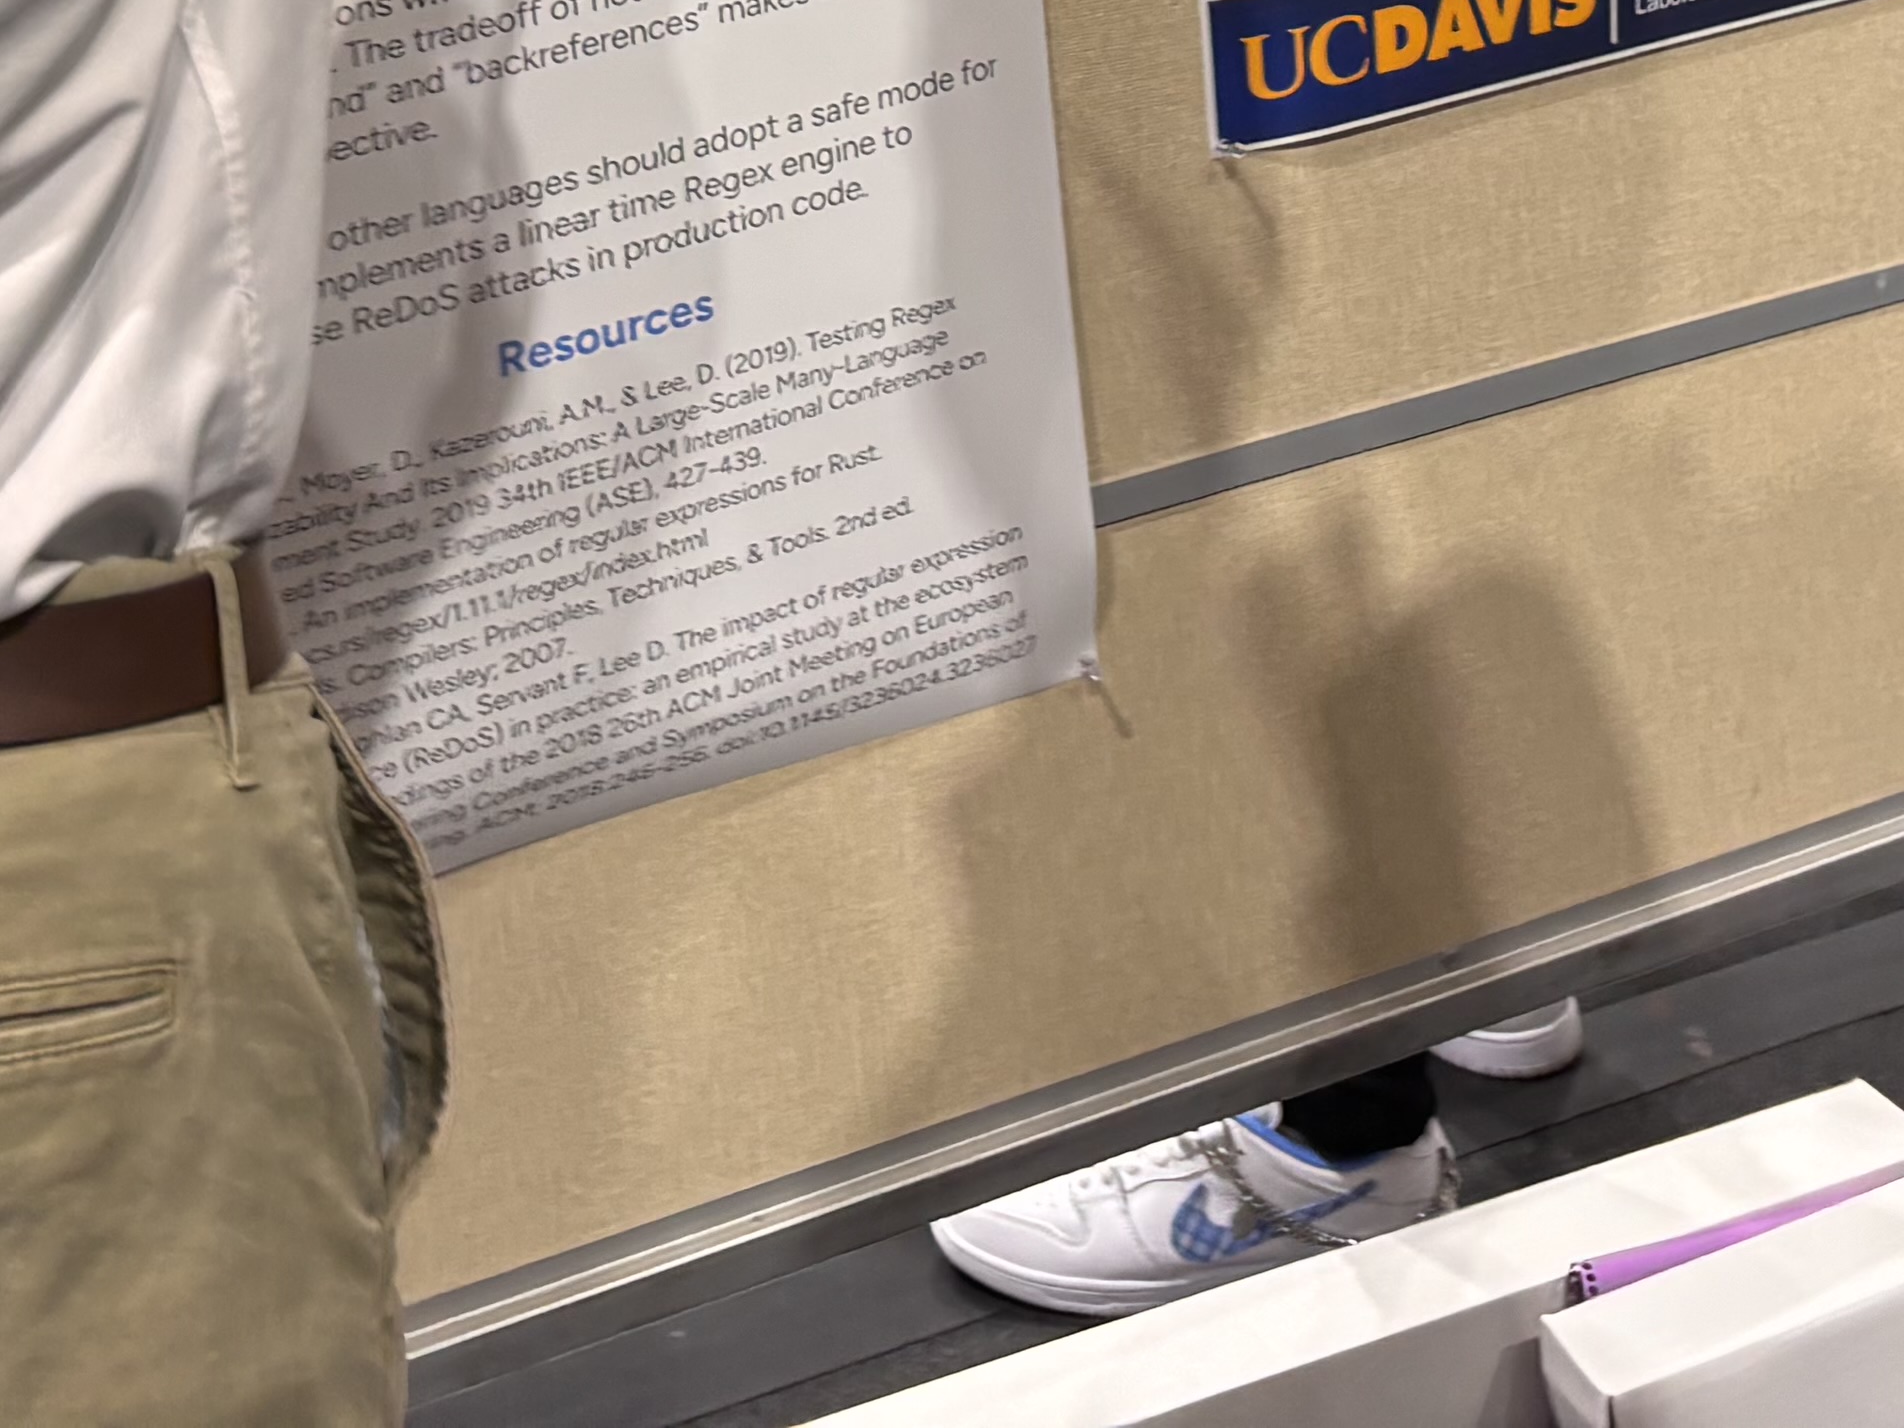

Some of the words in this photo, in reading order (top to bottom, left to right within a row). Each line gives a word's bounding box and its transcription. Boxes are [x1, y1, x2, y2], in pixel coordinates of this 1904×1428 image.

[623, 205, 785, 270] production
[792, 177, 868, 217] code.
[498, 290, 715, 377] Resources
[724, 335, 803, 383] (2019).
[806, 319, 887, 353] Testing
[892, 293, 958, 330] Regex
